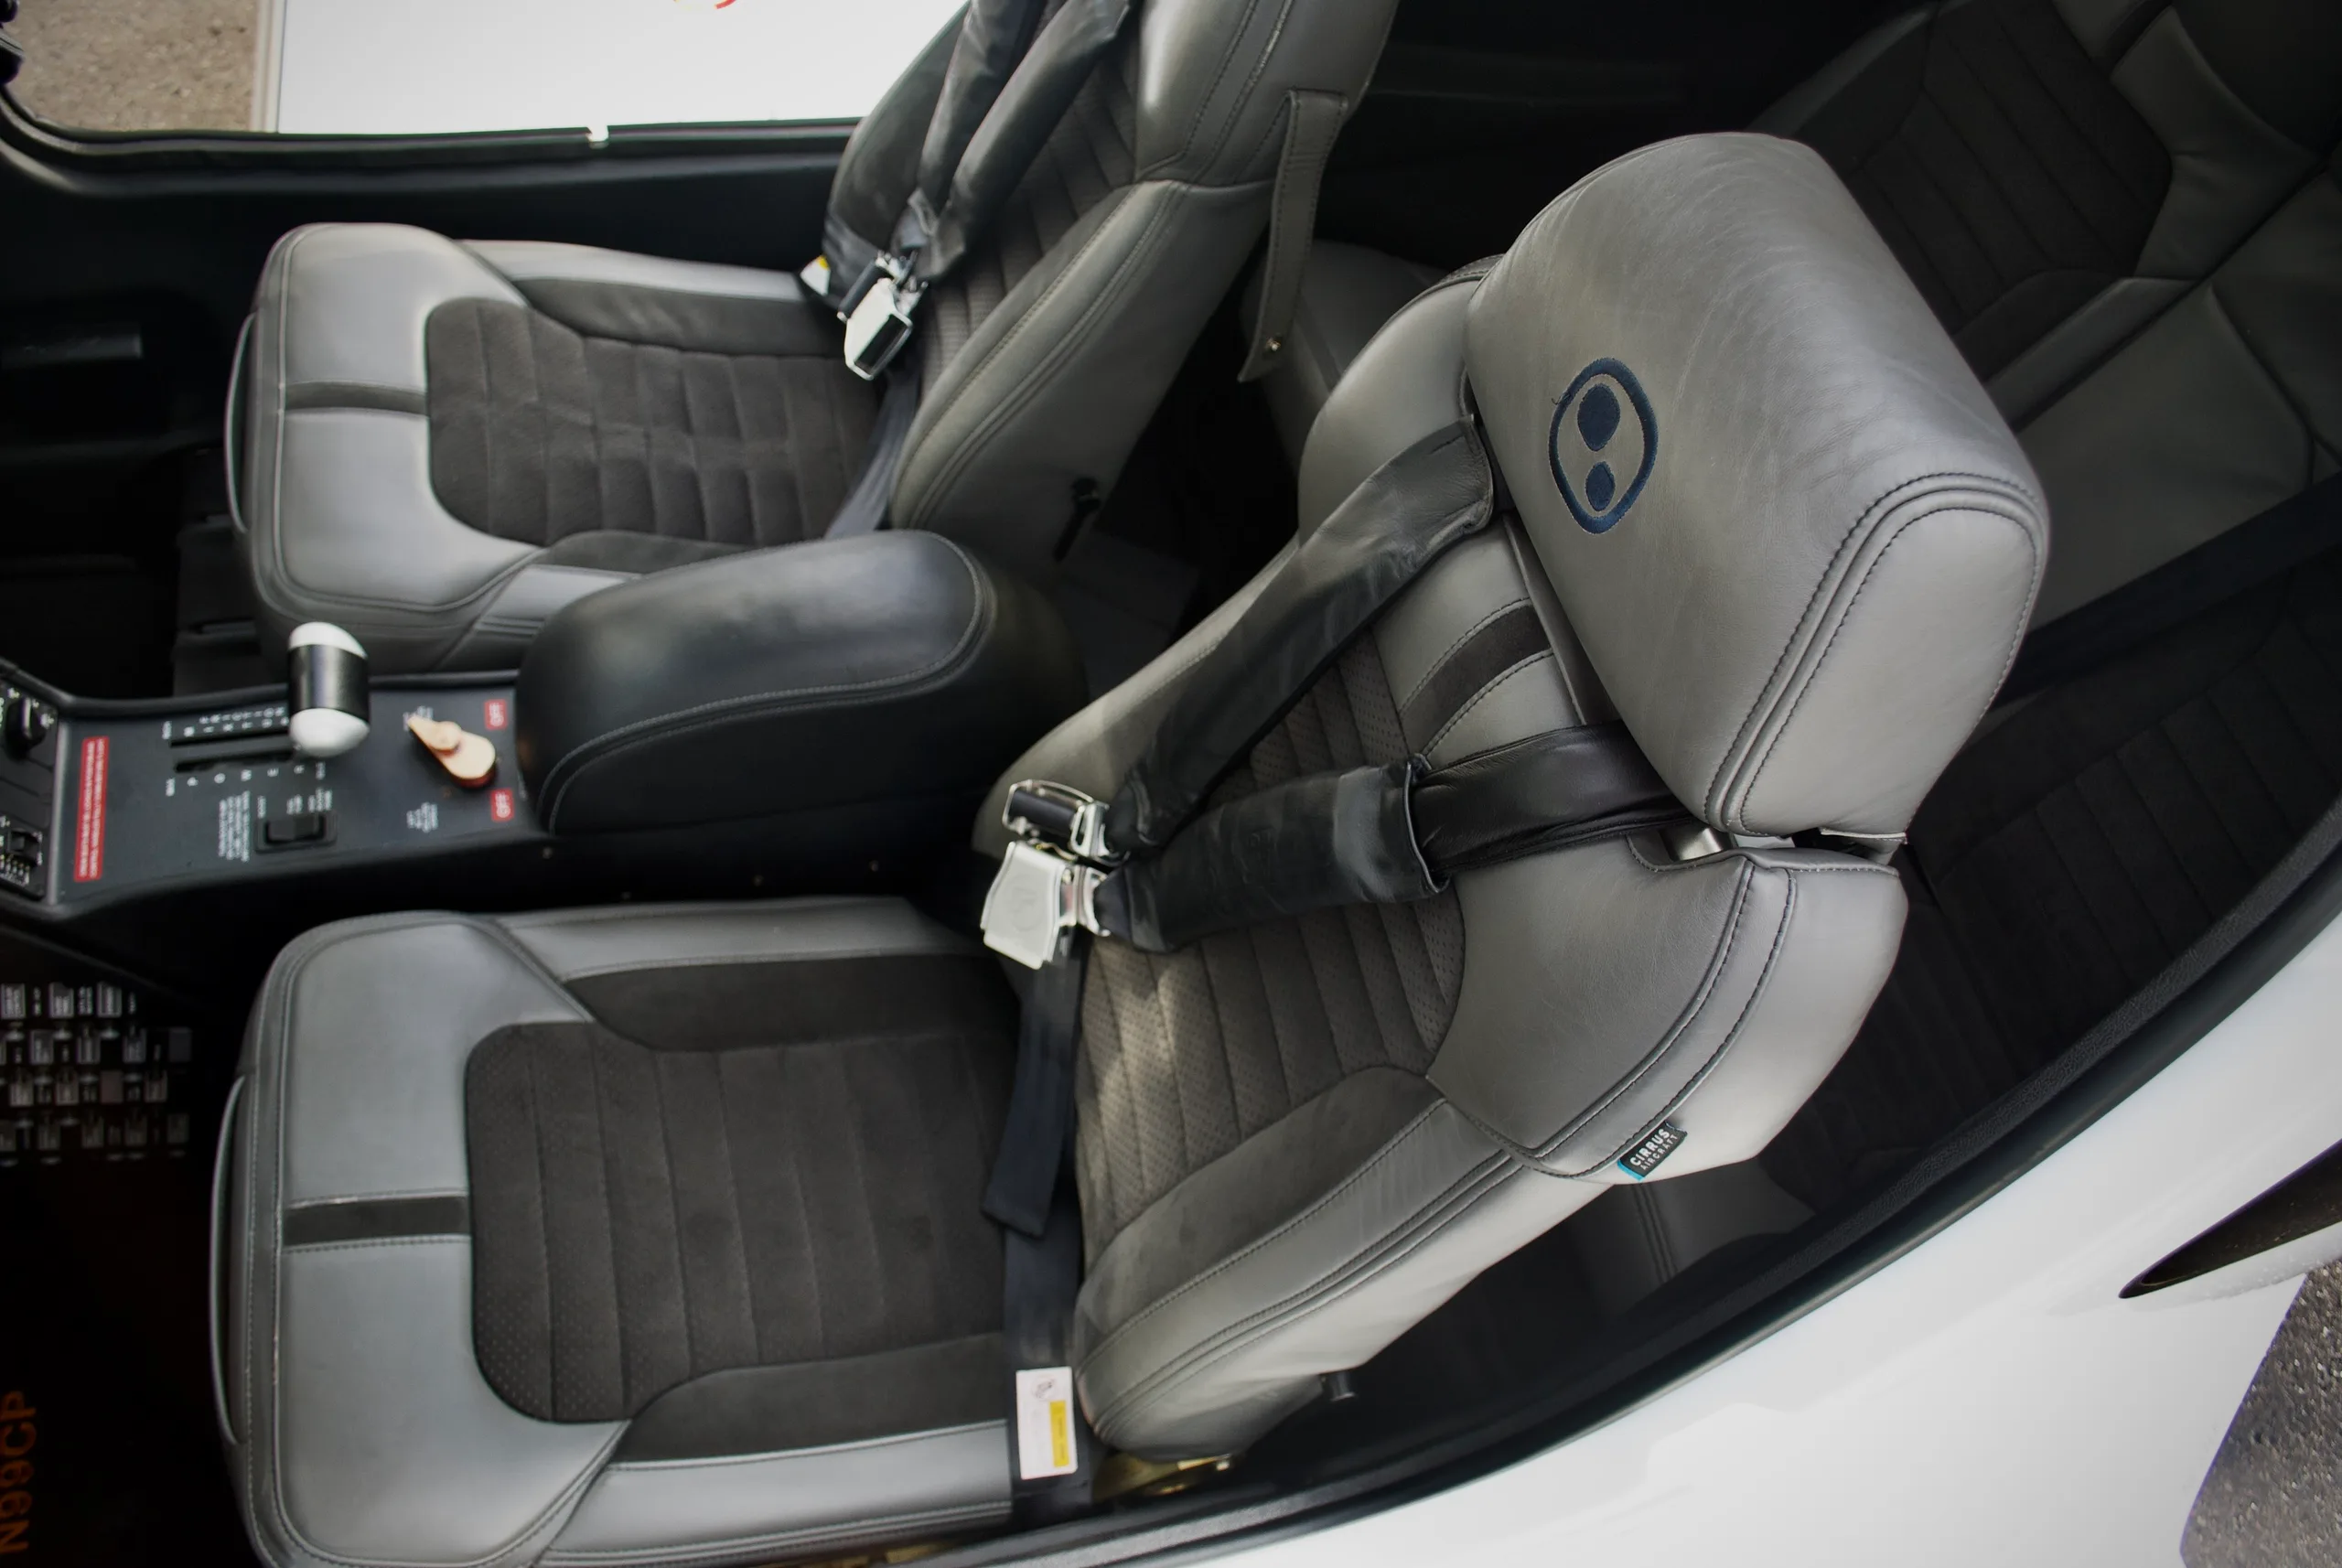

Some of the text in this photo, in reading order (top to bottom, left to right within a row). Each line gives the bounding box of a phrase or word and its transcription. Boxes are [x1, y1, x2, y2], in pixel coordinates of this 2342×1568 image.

[188, 765, 305, 787] POWER
[1629, 1128, 1671, 1166] CIRRUS
[1640, 1134, 1679, 1171] AIRCRAFT
[0, 1390, 37, 1555] N99CP
